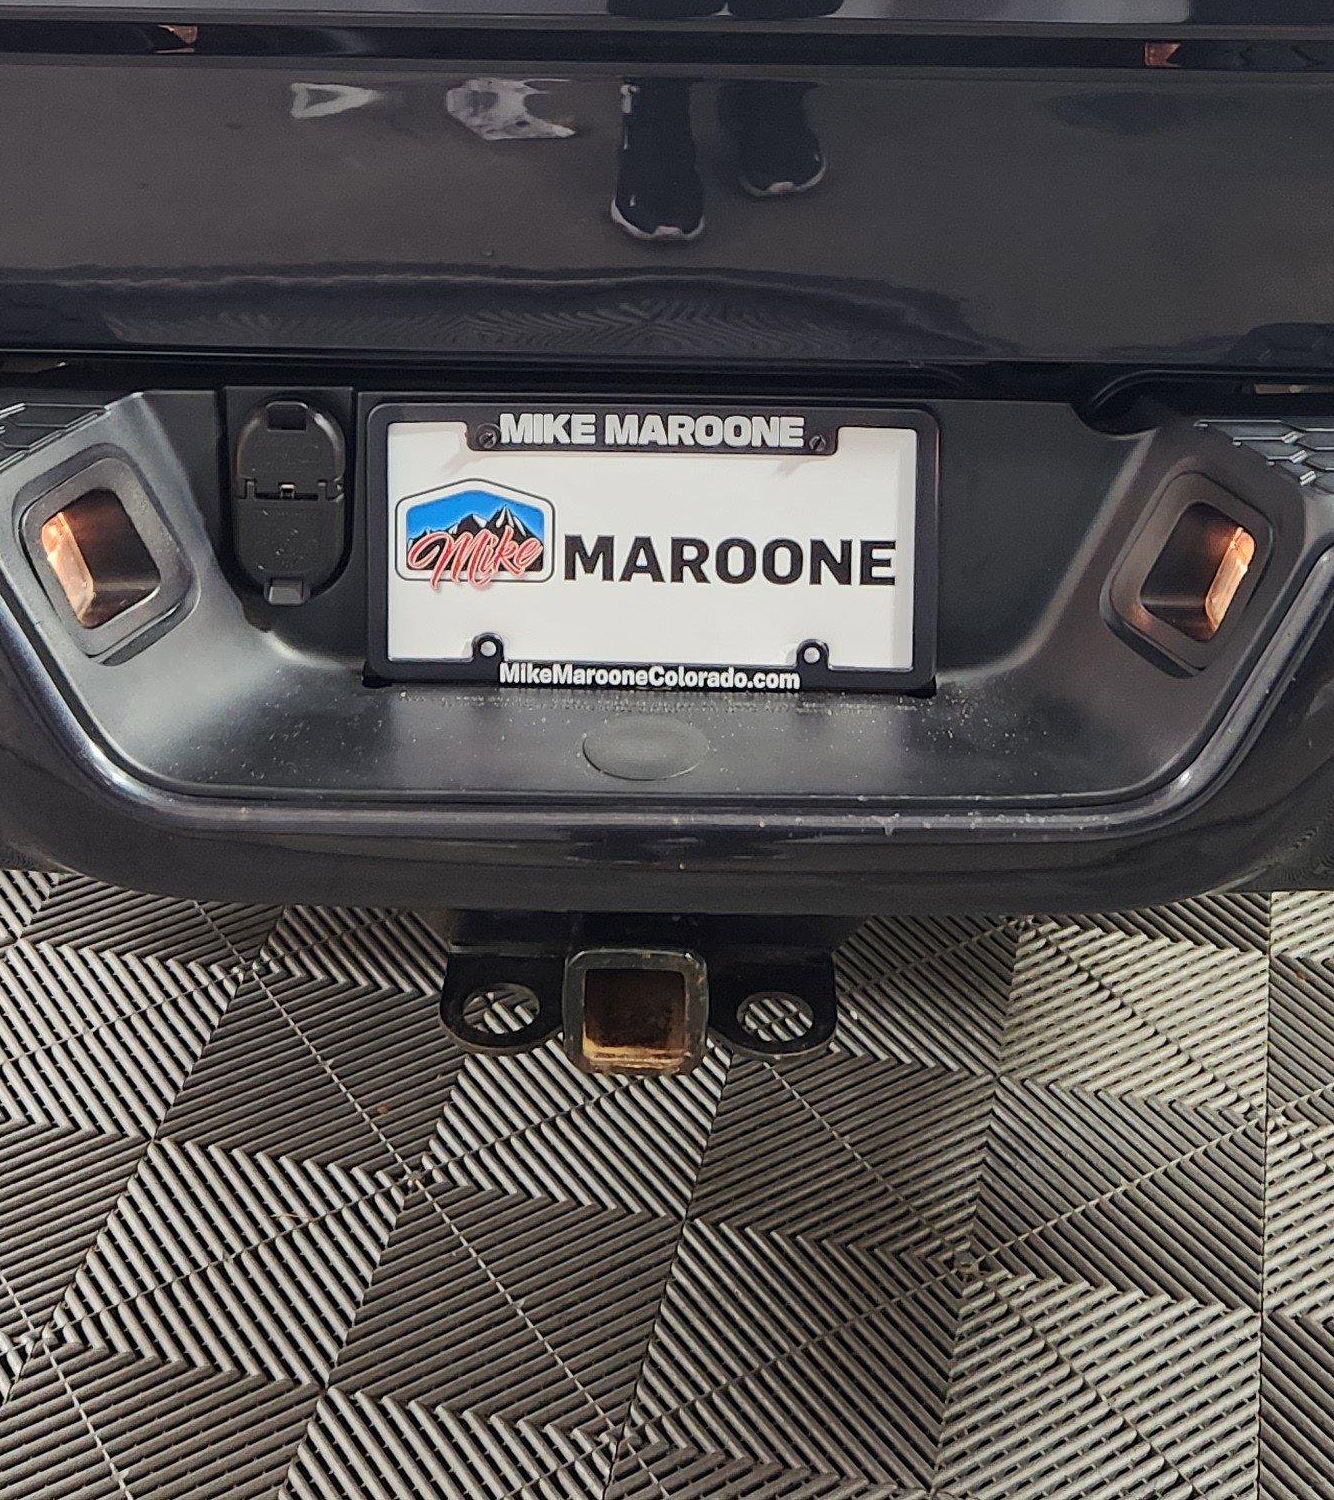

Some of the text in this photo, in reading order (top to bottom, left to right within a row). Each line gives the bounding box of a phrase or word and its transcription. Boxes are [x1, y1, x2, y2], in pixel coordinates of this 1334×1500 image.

[500, 413, 805, 448] MIKE MAROONE
[408, 528, 897, 590] Mike MAROONE
[499, 662, 801, 690] MikeMarooneColorado.com
